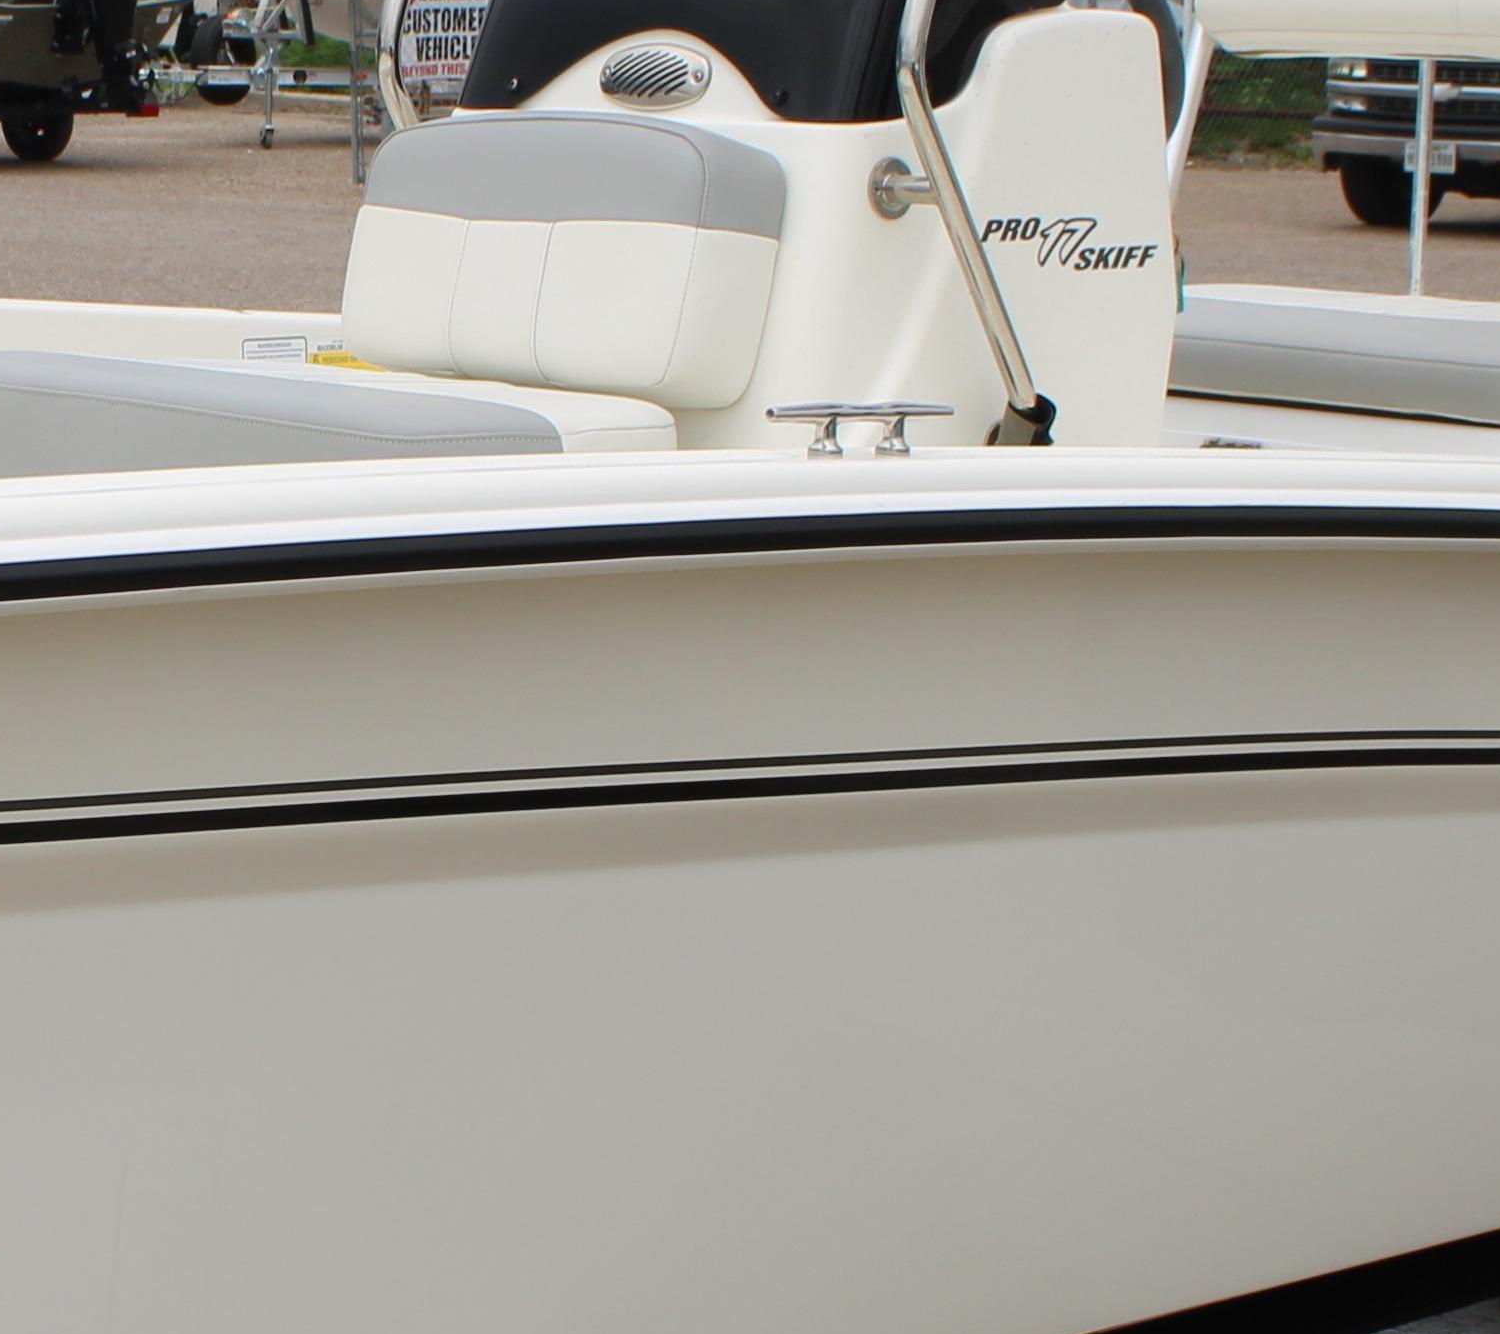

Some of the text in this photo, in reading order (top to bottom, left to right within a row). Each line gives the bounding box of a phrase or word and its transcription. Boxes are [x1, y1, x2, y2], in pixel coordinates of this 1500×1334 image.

[980, 217, 1041, 243] PRO
[1037, 217, 1098, 268] 17
[1073, 244, 1159, 271] SKIFF
